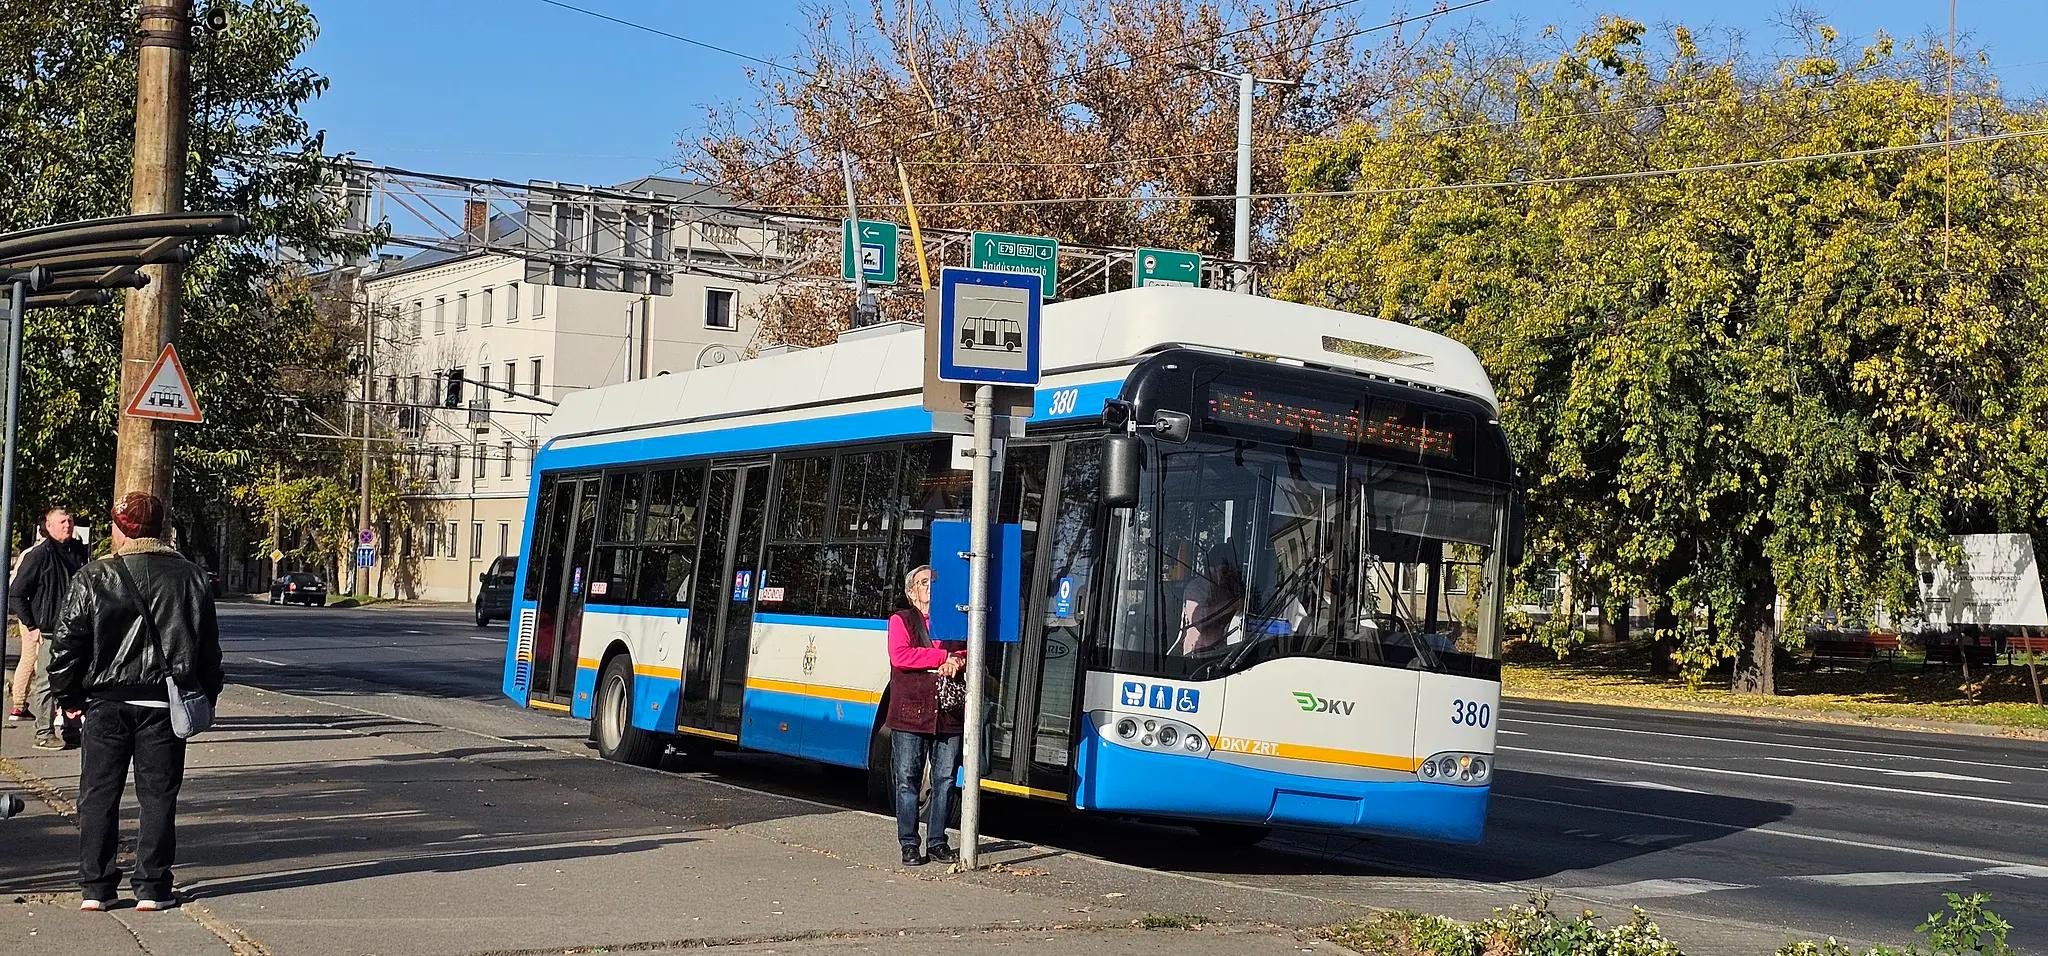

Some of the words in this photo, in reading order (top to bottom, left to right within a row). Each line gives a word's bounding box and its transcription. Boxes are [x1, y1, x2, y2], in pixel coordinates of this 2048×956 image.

[1000, 245, 1013, 253] E79
[1019, 246, 1033, 255] E573
[1041, 248, 1047, 257] 4
[1050, 389, 1078, 415] 380
[1315, 698, 1356, 717] DKV
[1451, 699, 1490, 729] 380
[1220, 737, 1251, 752] DKV
[1251, 740, 1281, 756] ZRT.
